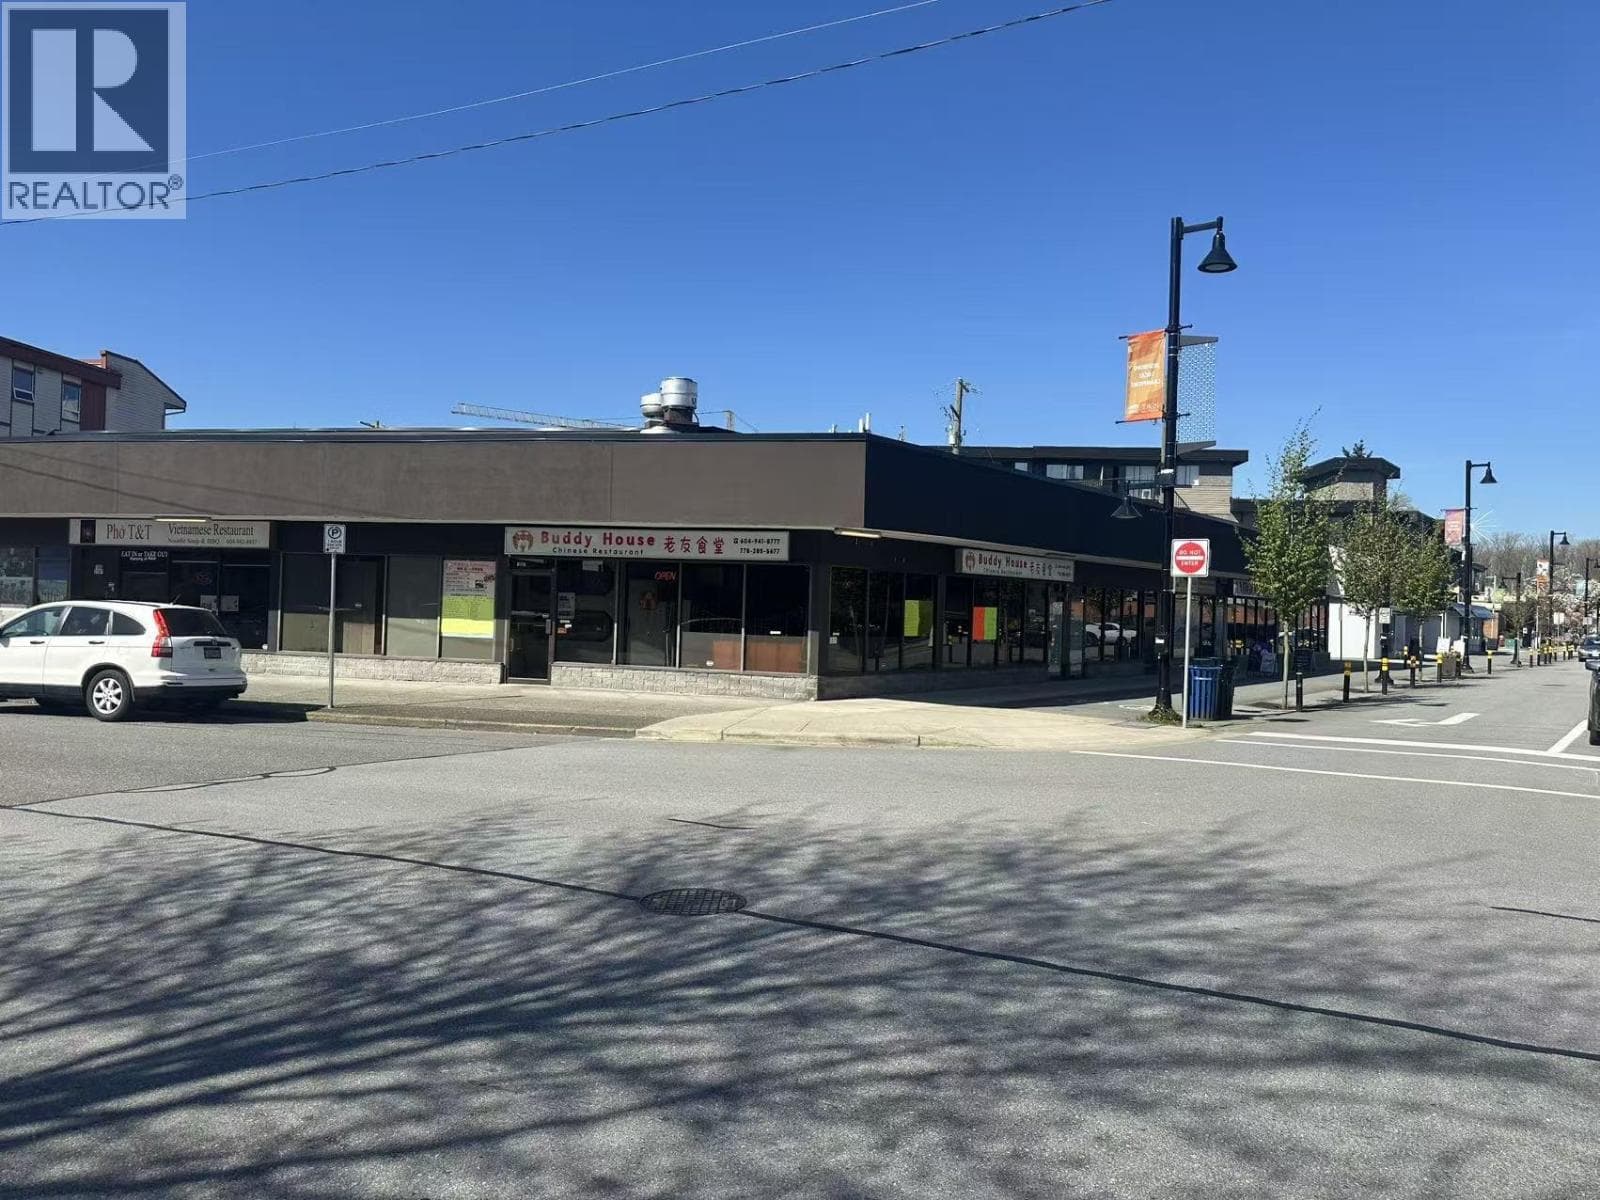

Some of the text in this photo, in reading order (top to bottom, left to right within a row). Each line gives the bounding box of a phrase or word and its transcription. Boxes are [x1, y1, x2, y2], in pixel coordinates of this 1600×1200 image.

[128, 524, 153, 540] T&T
[168, 523, 254, 536] Vietnamese Restaurant
[540, 531, 656, 548] Buddy House
[664, 535, 725, 554] 老友食堂
[978, 553, 1028, 569] Buddy House
[654, 570, 677, 582] OPEN
